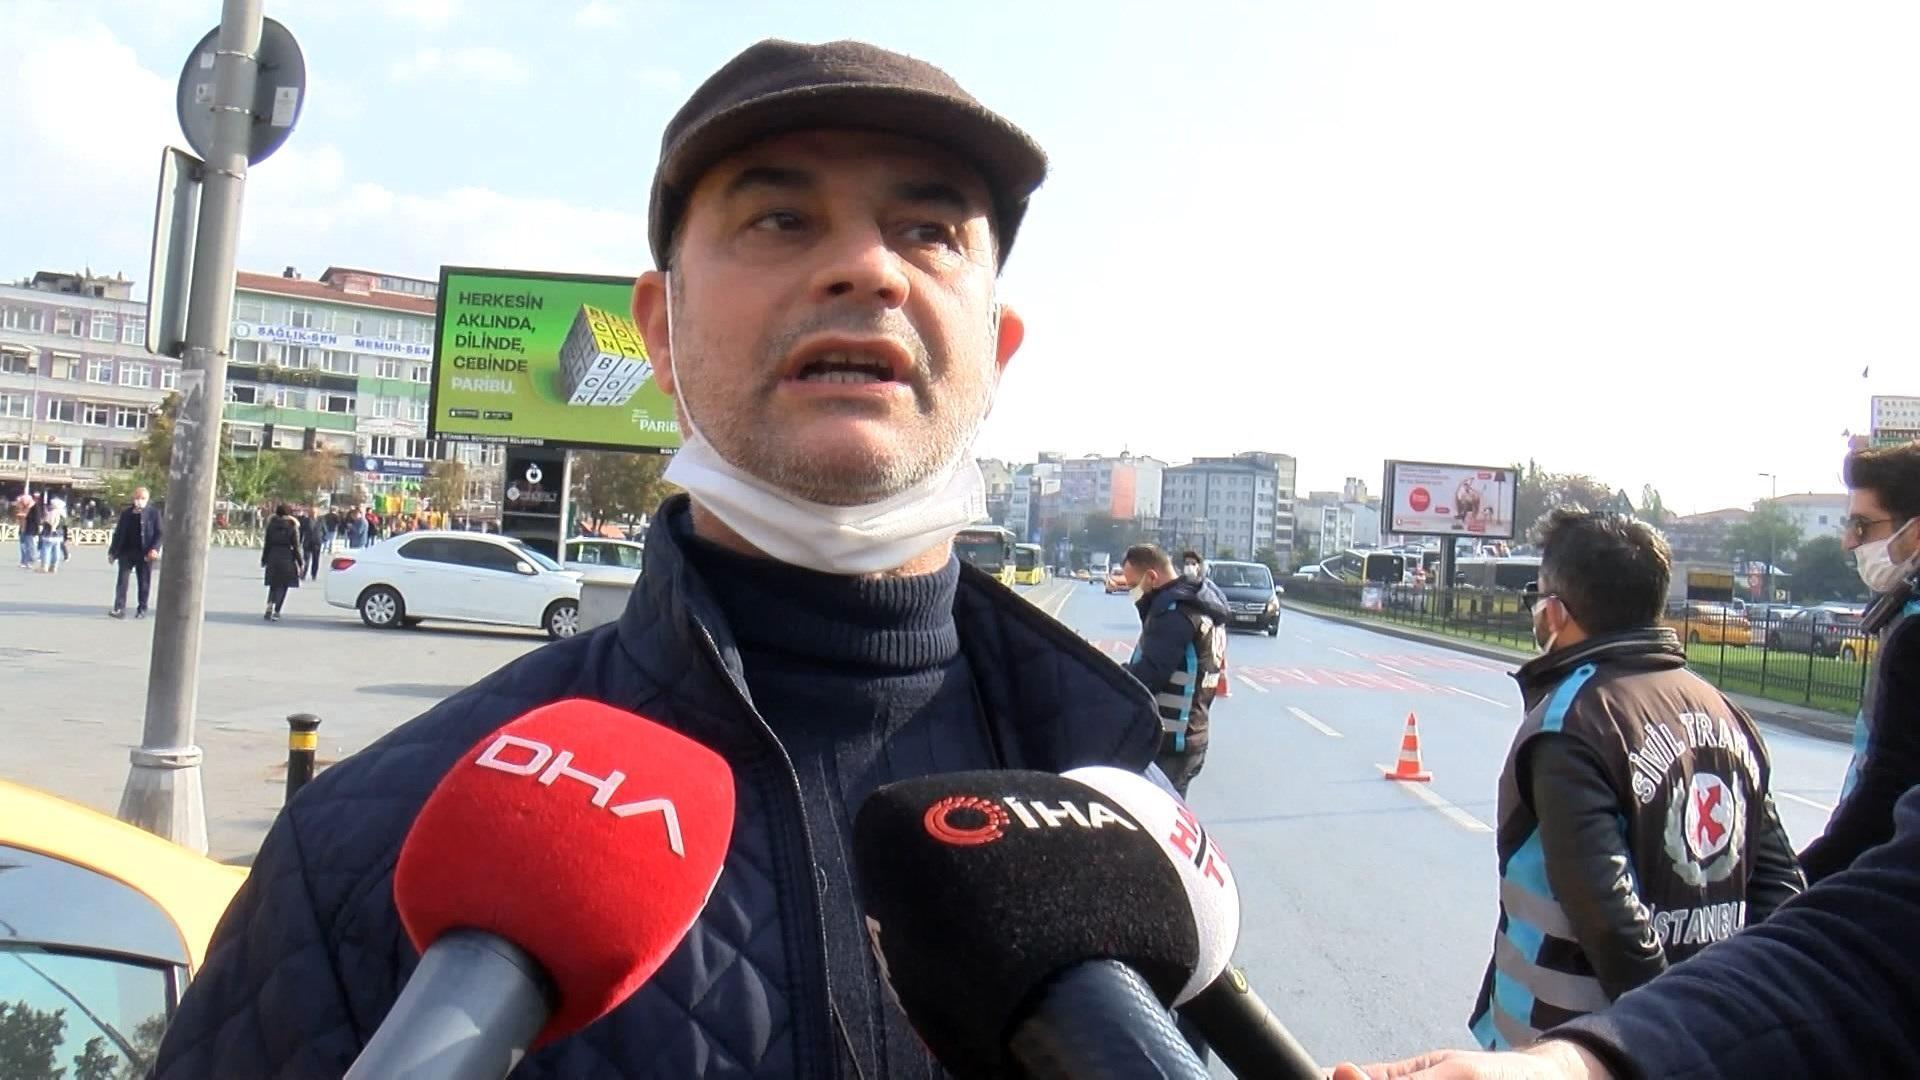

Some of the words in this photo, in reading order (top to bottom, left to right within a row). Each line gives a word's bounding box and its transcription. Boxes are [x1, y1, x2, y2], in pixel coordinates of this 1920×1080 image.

[459, 291, 543, 310] HERKESİN
[456, 313, 536, 334] AKLINDA,
[257, 326, 337, 345] SAĞLIK-SEN
[354, 338, 431, 356] MEMUR-SEN
[455, 331, 525, 354] DİLİNDE,
[453, 353, 529, 373] CEBİNDE
[1628, 721, 1686, 804] SİVİL
[475, 735, 685, 858] DHA
[1003, 797, 1138, 831] İHA
